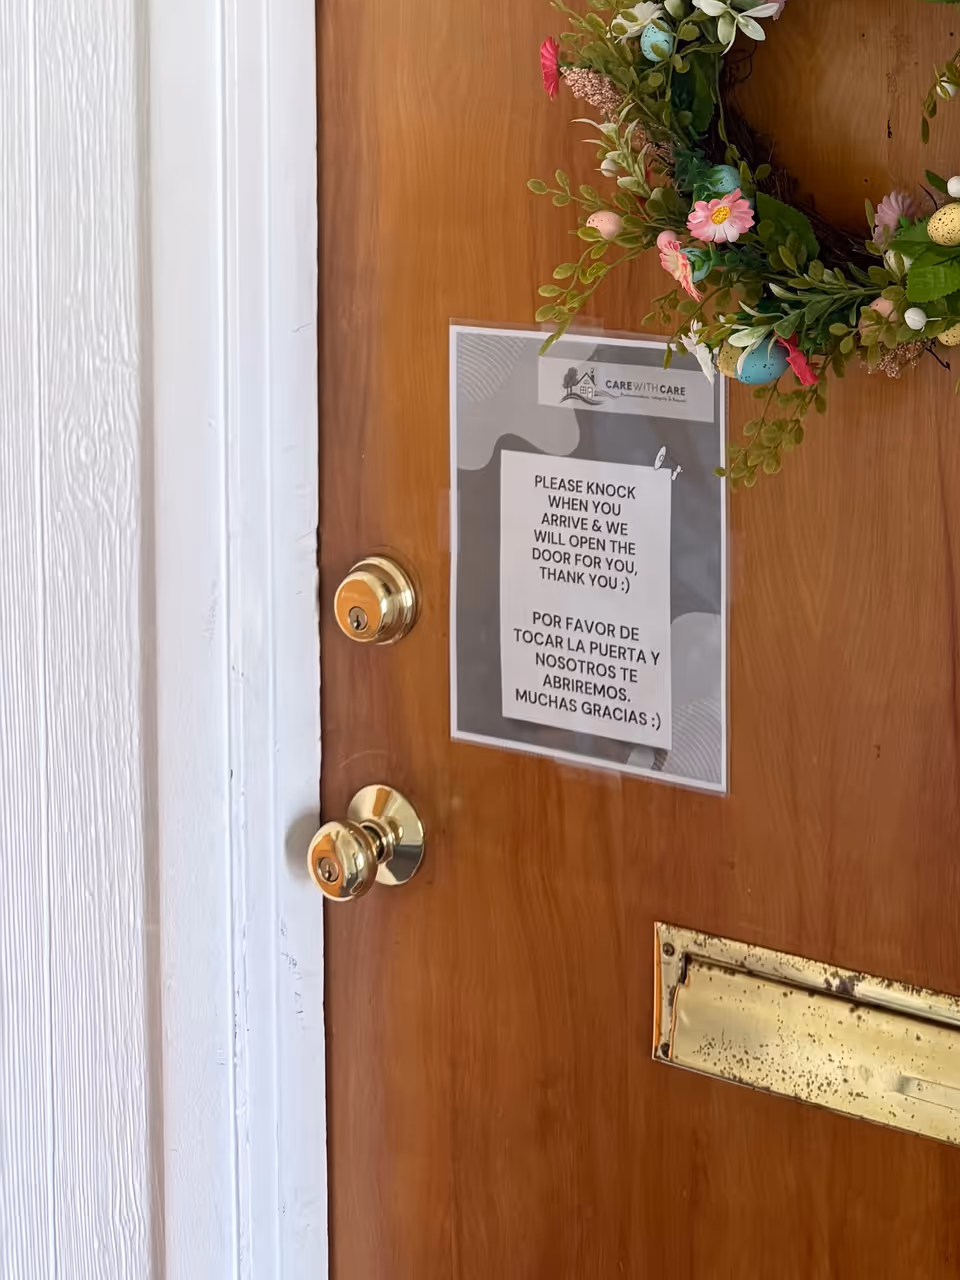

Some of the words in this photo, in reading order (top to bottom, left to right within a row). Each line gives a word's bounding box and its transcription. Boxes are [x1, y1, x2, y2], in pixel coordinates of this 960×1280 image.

[534, 474, 583, 494] PLEASE
[586, 481, 636, 499] KNOCK
[548, 494, 589, 512] WHEN
[592, 500, 622, 516] YOU
[541, 512, 588, 531] ARRIVE
[591, 519, 602, 533] &
[606, 520, 628, 536] WE
[534, 529, 565, 546] WILL
[568, 534, 606, 551] OPEN
[609, 539, 636, 555] THE
[532, 547, 571, 565] DOOR
[574, 553, 601, 569] FOR
[605, 557, 638, 576] YOU,
[539, 566, 585, 585] THANK
[589, 573, 618, 589] YOU
[532, 611, 562, 629] POR
[566, 617, 616, 638] FAVOR
[620, 625, 640, 641] DE
[513, 628, 563, 649] TOCAR
[567, 637, 586, 653] LA
[589, 641, 647, 664] PUERTA
[651, 651, 660, 666] Y
[535, 652, 617, 679] NOSOTROS
[620, 667, 638, 683] TE
[542, 674, 631, 703] ABRIREMOS.
[515, 688, 577, 712] MUCHAS
[581, 701, 648, 726] GRACIAS
